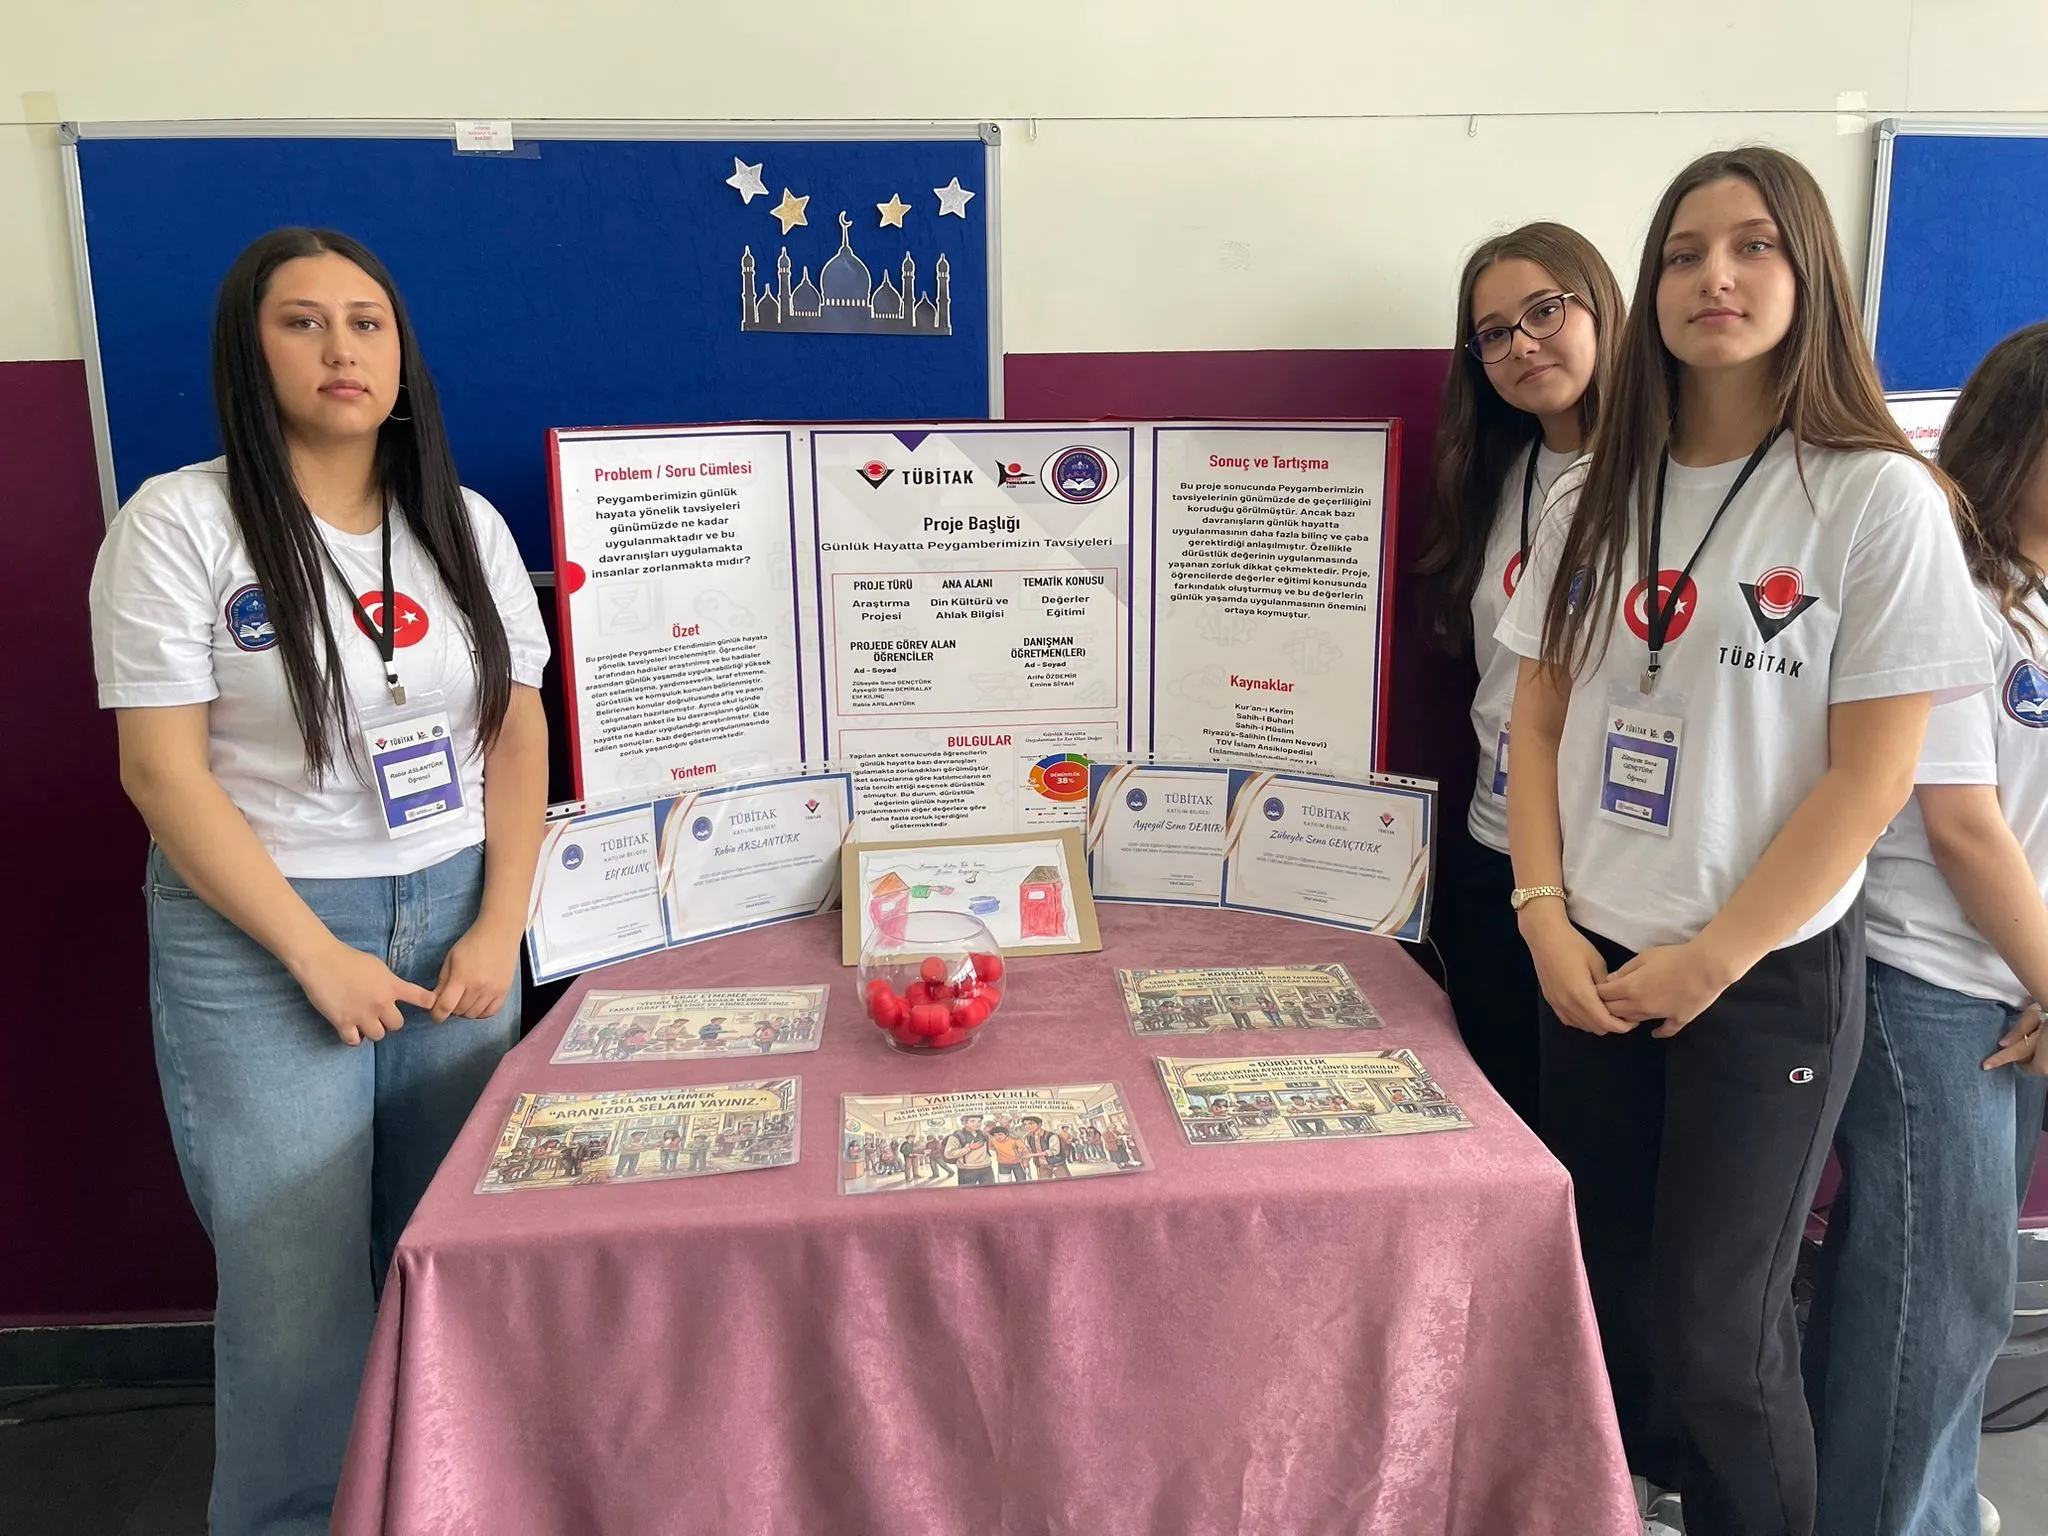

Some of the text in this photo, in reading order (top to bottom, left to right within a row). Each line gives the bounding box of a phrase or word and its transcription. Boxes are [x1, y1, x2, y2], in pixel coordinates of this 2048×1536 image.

[1210, 455, 1329, 471] Sonuç ve Tartışma
[595, 467, 652, 481] Problem
[665, 465, 696, 478] Soru
[700, 461, 752, 476] Cümlesi
[902, 467, 974, 485] TÜBİTAK
[1180, 482, 1194, 490] Bu
[1196, 483, 1222, 491] proje
[1278, 484, 1364, 494] Peygamberimizin
[597, 488, 737, 505] Peygamberimizin günlük
[1172, 494, 1238, 502] tavsiyelerinin
[1240, 495, 1296, 504] günümüzde
[1312, 498, 1371, 506] geçerliliğini
[596, 502, 740, 520] hayata yönelik tavsiyeleri
[1187, 505, 1355, 518] koruduğu görülmüştür. Ancak bazı
[610, 517, 729, 534] günümüzde ne kadar
[924, 516, 1020, 534] Proje Başlığı
[605, 530, 735, 548] uygulanmaktadır ve bu
[1172, 528, 1248, 536] uygulanmasının
[1276, 530, 1299, 538] fazla
[1301, 531, 1328, 541] bilinç
[1344, 534, 1369, 542] çaba
[821, 538, 1112, 552] Günlük Hayatta Peygamberimizin Tavsiyeleri
[599, 544, 743, 563] davranışları uygulamakta
[1182, 550, 1358, 564] dürüstlük değerinin uygulanmasında
[592, 556, 751, 578] insanlar zorlanmakta mıdır?
[854, 579, 913, 591] PROJE TÜRÜ
[942, 578, 993, 589] ANA ALANI
[1023, 576, 1104, 587] TEMATİK KONUSU
[852, 600, 910, 608] Araştırma
[931, 598, 948, 607] Din
[951, 597, 993, 606] Kültürü
[1042, 595, 1090, 605] Değerler
[1170, 593, 1203, 602] günlük
[1250, 598, 1325, 608] uygulanmasının
[1327, 602, 1366, 612] önemini
[861, 612, 901, 622] Projesi
[936, 610, 1004, 620] Ahlak Bilgisi
[1046, 608, 1085, 618] Eğitimi
[1224, 607, 1310, 619] ortaya koymuştur.
[672, 623, 700, 638] Özet
[850, 639, 956, 651] PROJEDE GÖREV ALAN
[1023, 636, 1073, 648] DANIŞMAN
[873, 651, 934, 662] ÖĞRENCİLER
[1011, 647, 1086, 658] ÖĞRETMEN(LER)
[1719, 646, 1804, 678] TÜBİTAK
[1231, 675, 1295, 692] Kaynaklar
[1269, 707, 1294, 715] Kerim
[1267, 716, 1294, 725] Buhari
[948, 735, 1012, 747] BULGULAR
[1234, 740, 1256, 749] İslam
[1257, 744, 1313, 756] Ansiklopedisi
[390, 770, 407, 779] Rabia
[670, 764, 716, 779] Yöntem
[1164, 792, 1213, 805] TÜBİTAK
[729, 809, 777, 825] TÜBİTAK
[1302, 805, 1351, 821] TÜBİTAK
[601, 832, 649, 852] TÜBİTAK
[714, 833, 800, 856] Rabia ARSLANTÜRK
[1257, 1059, 1327, 1068] DÜRÜSTLÜK
[611, 1092, 715, 1105] SELAM VERMEK
[924, 1090, 1040, 1104] YARDIMSEVERLİK
[638, 1101, 695, 1112] SELAMI
